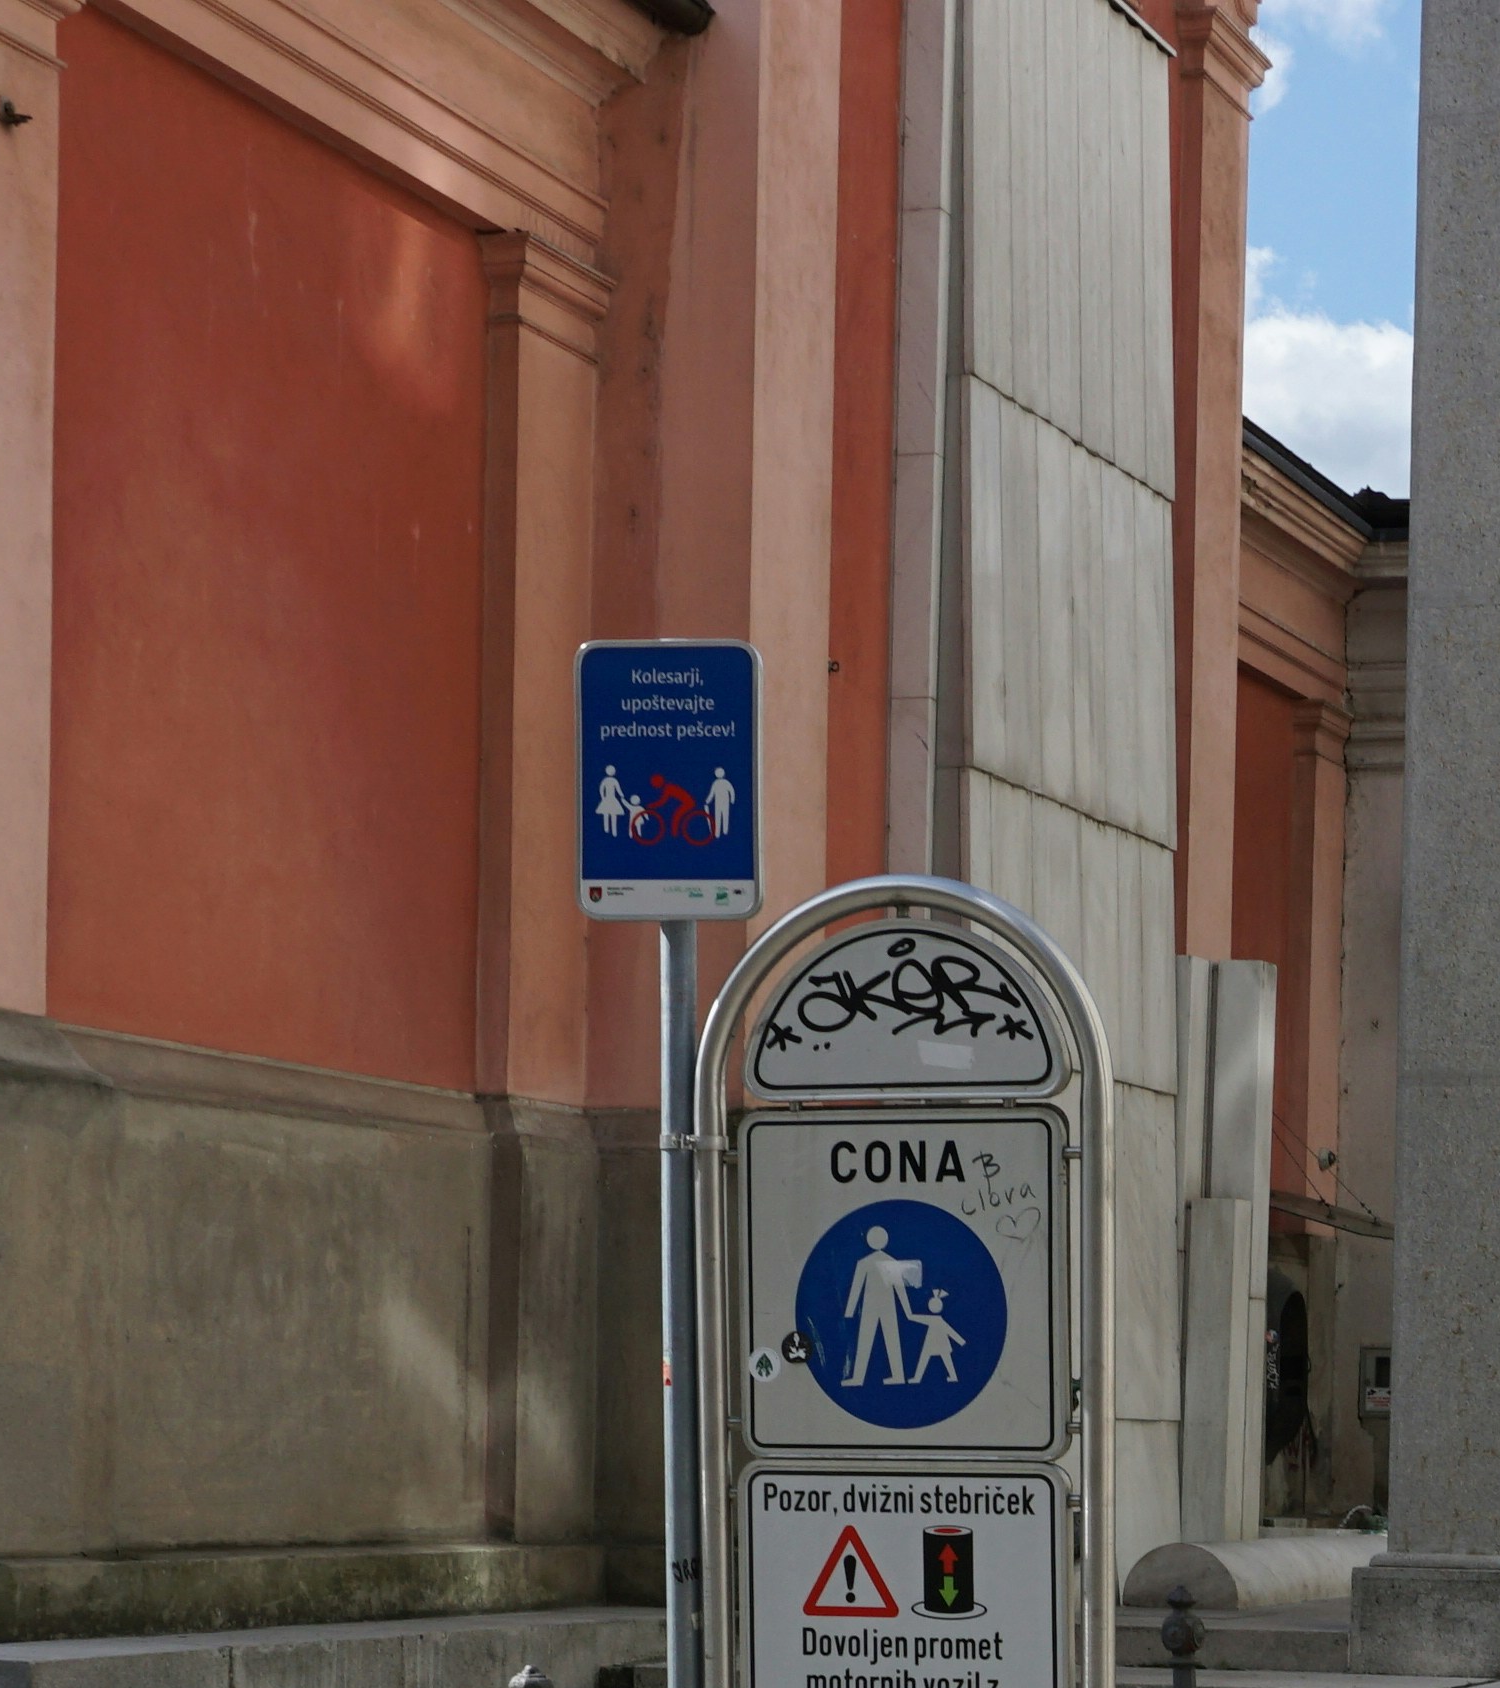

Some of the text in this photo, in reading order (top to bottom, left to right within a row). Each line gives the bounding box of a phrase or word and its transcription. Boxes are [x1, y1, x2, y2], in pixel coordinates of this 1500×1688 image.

[631, 668, 704, 687] Kolesarji,
[621, 694, 715, 714] upoštevajte
[600, 720, 736, 741] prednost pešcev!
[831, 1140, 965, 1184] CONA
[763, 1483, 1035, 1516] Pozor, dvižni stebriček
[803, 1627, 1003, 1665] Dovoljen promet
